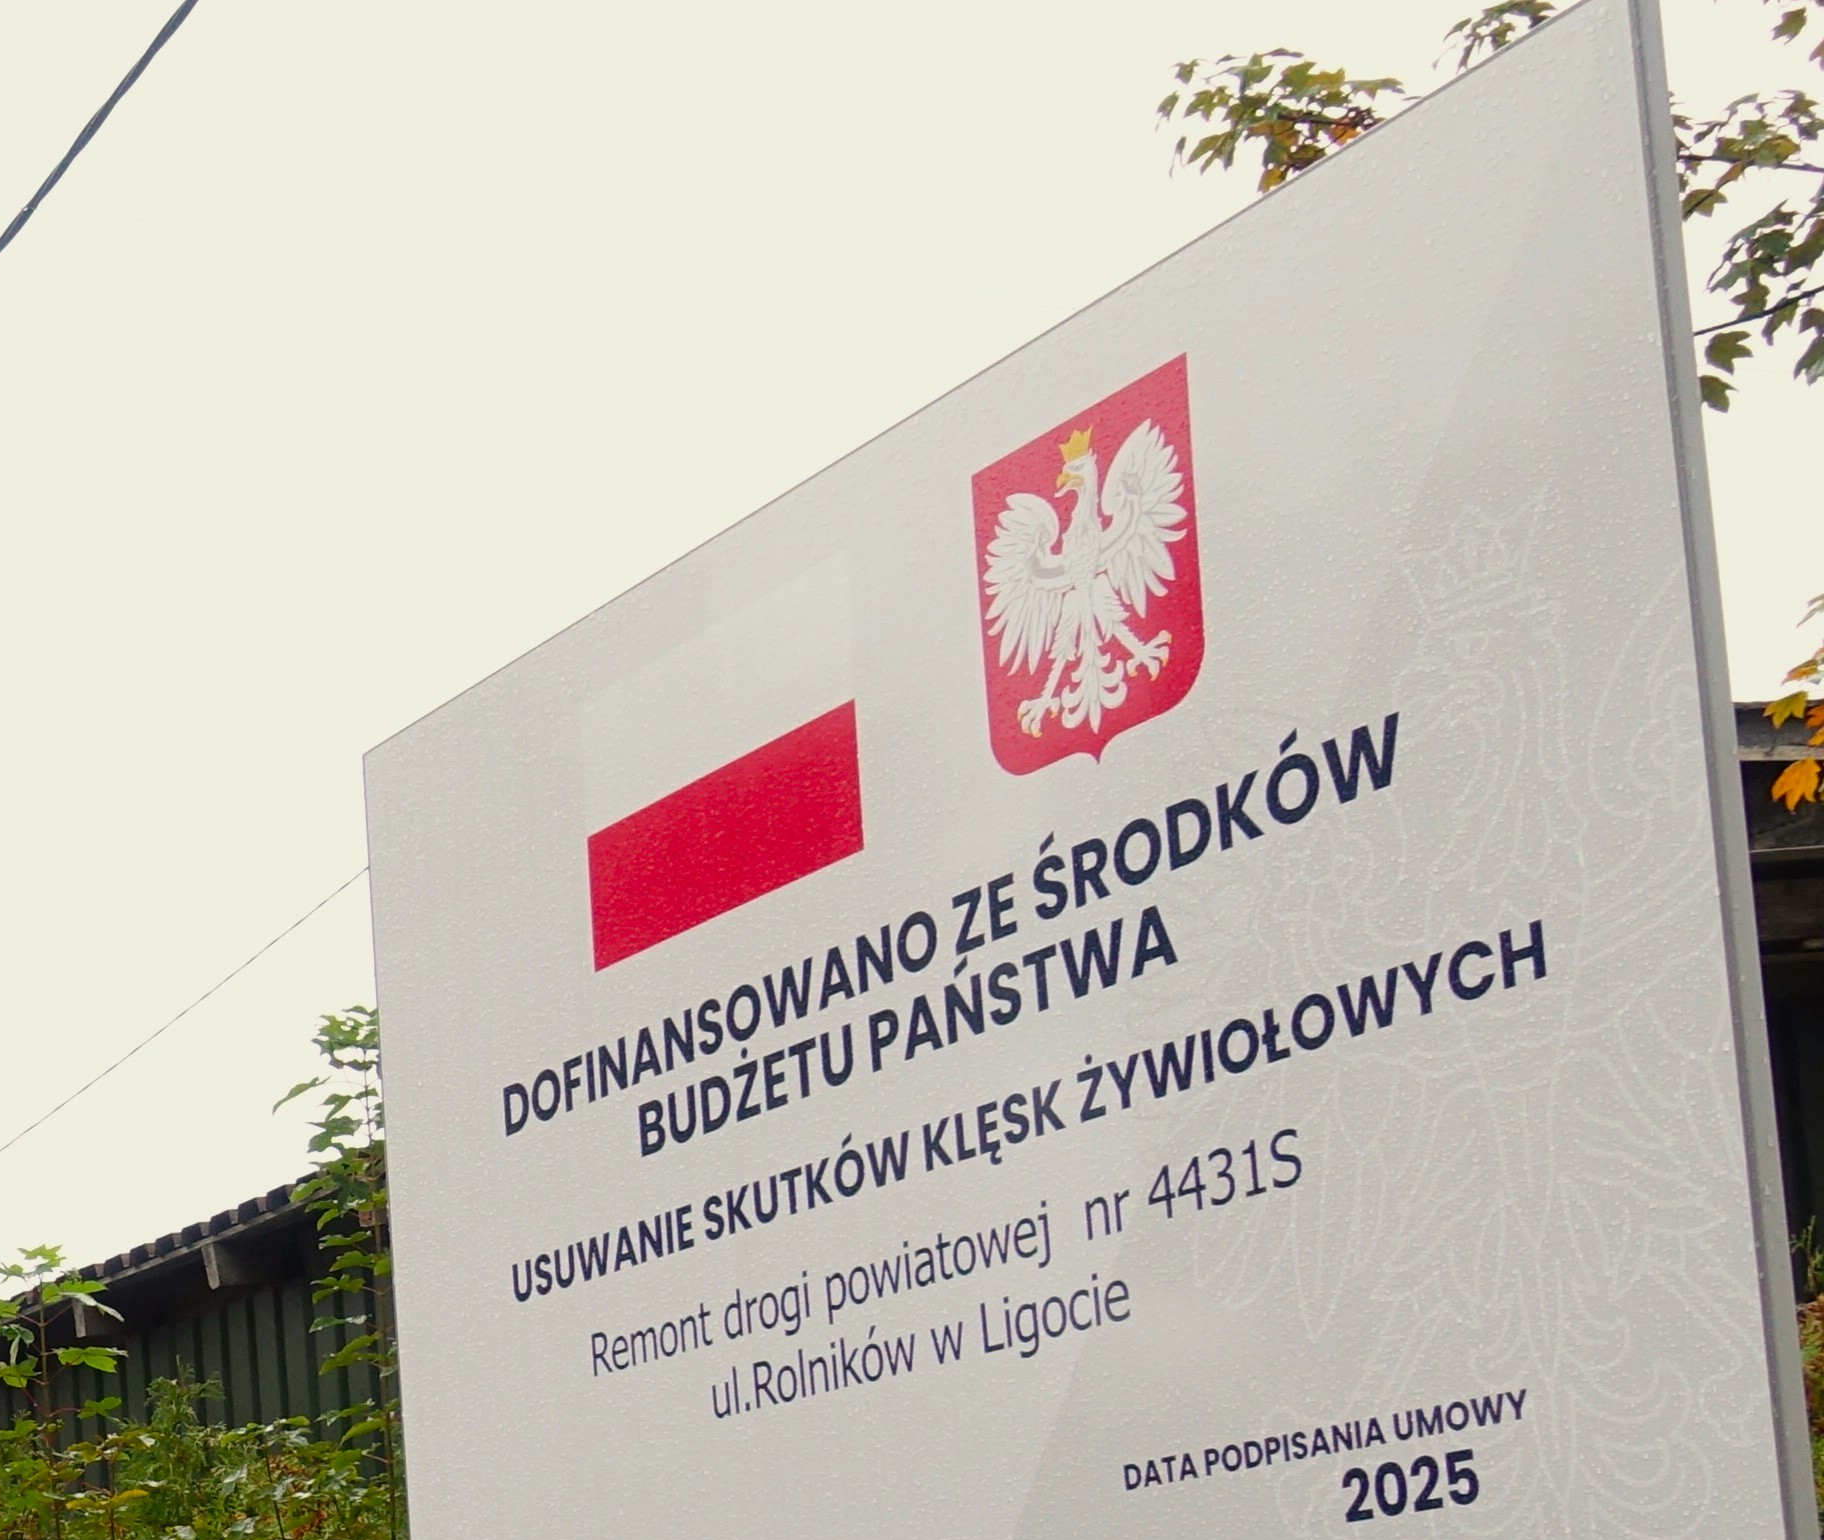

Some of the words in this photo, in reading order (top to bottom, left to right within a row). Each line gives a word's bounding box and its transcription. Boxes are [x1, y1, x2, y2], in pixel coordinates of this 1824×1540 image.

[502, 910, 939, 1138] DOFINANSOWANO
[950, 871, 1019, 956] ZE
[1031, 710, 1400, 921] ŚRODKÓW
[637, 1022, 855, 1158] BUDŻETU
[867, 904, 1179, 1074] PAŃSTWA
[511, 1203, 696, 1304] USUWANIE
[702, 1130, 910, 1242] SKUTKÓW
[921, 1078, 1067, 1173] KLĘSK
[1075, 918, 1548, 1124] ŻYWIOŁOWYCH
[590, 1303, 714, 1376] Remont
[723, 1269, 813, 1341] drogi
[824, 1200, 1053, 1325] powiatowej
[1084, 1188, 1131, 1241] nr
[1147, 1127, 1303, 1220] 4431S
[711, 1325, 916, 1420] ul.Rolników
[929, 1321, 964, 1365] w
[979, 1273, 1132, 1360] Ligocie
[1122, 1451, 1200, 1492] DATA
[1202, 1416, 1388, 1477] PODPISANIA
[1391, 1387, 1528, 1442] UMOWY
[1341, 1447, 1481, 1524] 2025
